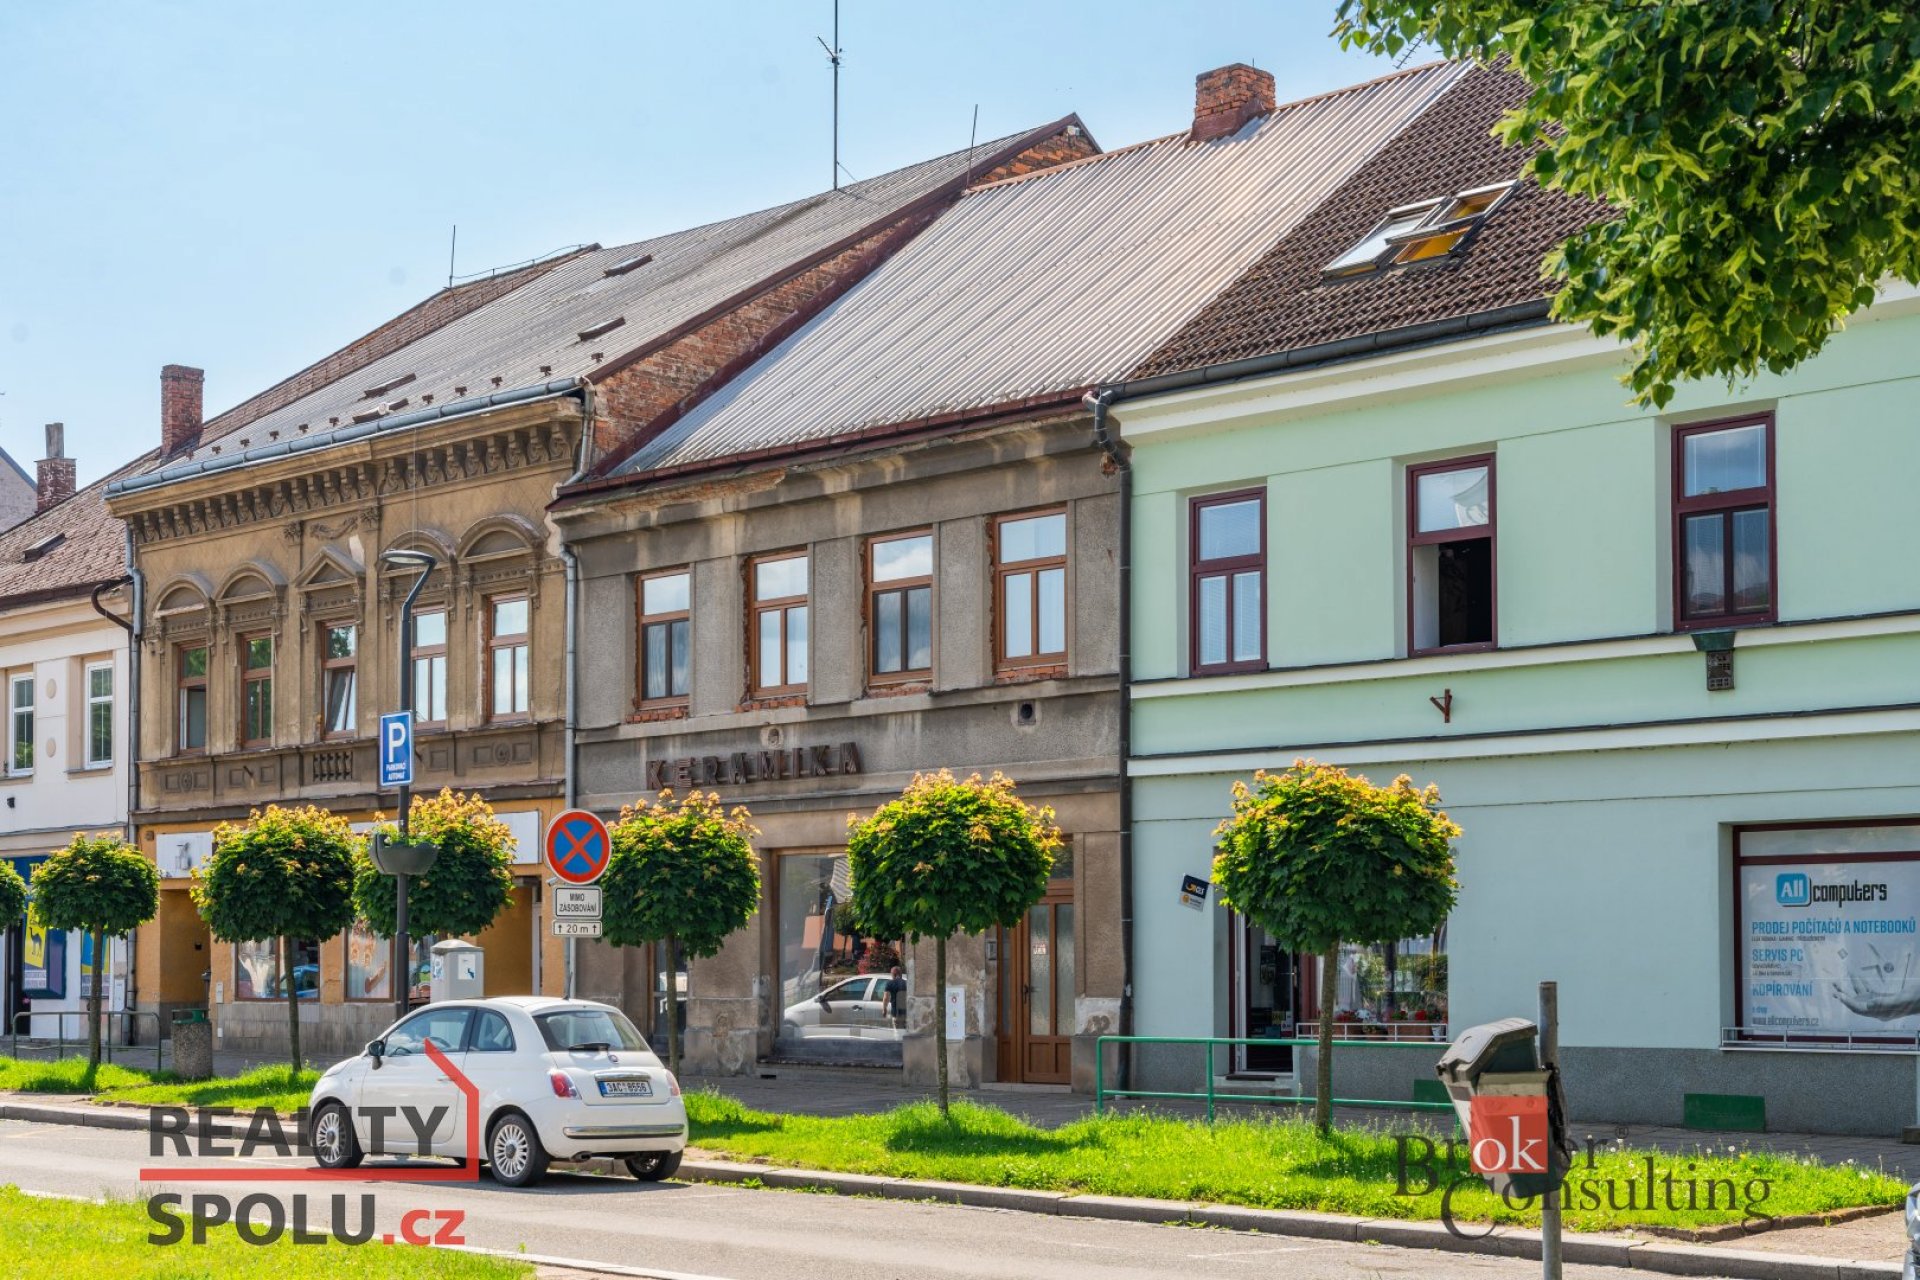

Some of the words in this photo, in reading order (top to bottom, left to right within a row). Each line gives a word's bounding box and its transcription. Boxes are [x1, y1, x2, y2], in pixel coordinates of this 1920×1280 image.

[388, 722, 406, 763] P
[646, 742, 862, 790] KERAMIKA
[569, 893, 585, 902] MIMO
[1781, 879, 1803, 898] All
[1812, 879, 1888, 908] computers
[559, 901, 597, 913] ZÁSOBOVÁNÍ
[566, 924, 578, 934] 20
[580, 926, 589, 934] m
[1751, 920, 1790, 935] PRODEJ
[1792, 917, 1842, 934] POČÍTAČŮ
[1843, 919, 1851, 933] A
[1853, 916, 1917, 934] NOTEBOOKŮ
[1752, 949, 1788, 962] SERVIS
[1790, 948, 1804, 962] PC
[1752, 981, 1813, 997] KOPÍROVÁNÍ
